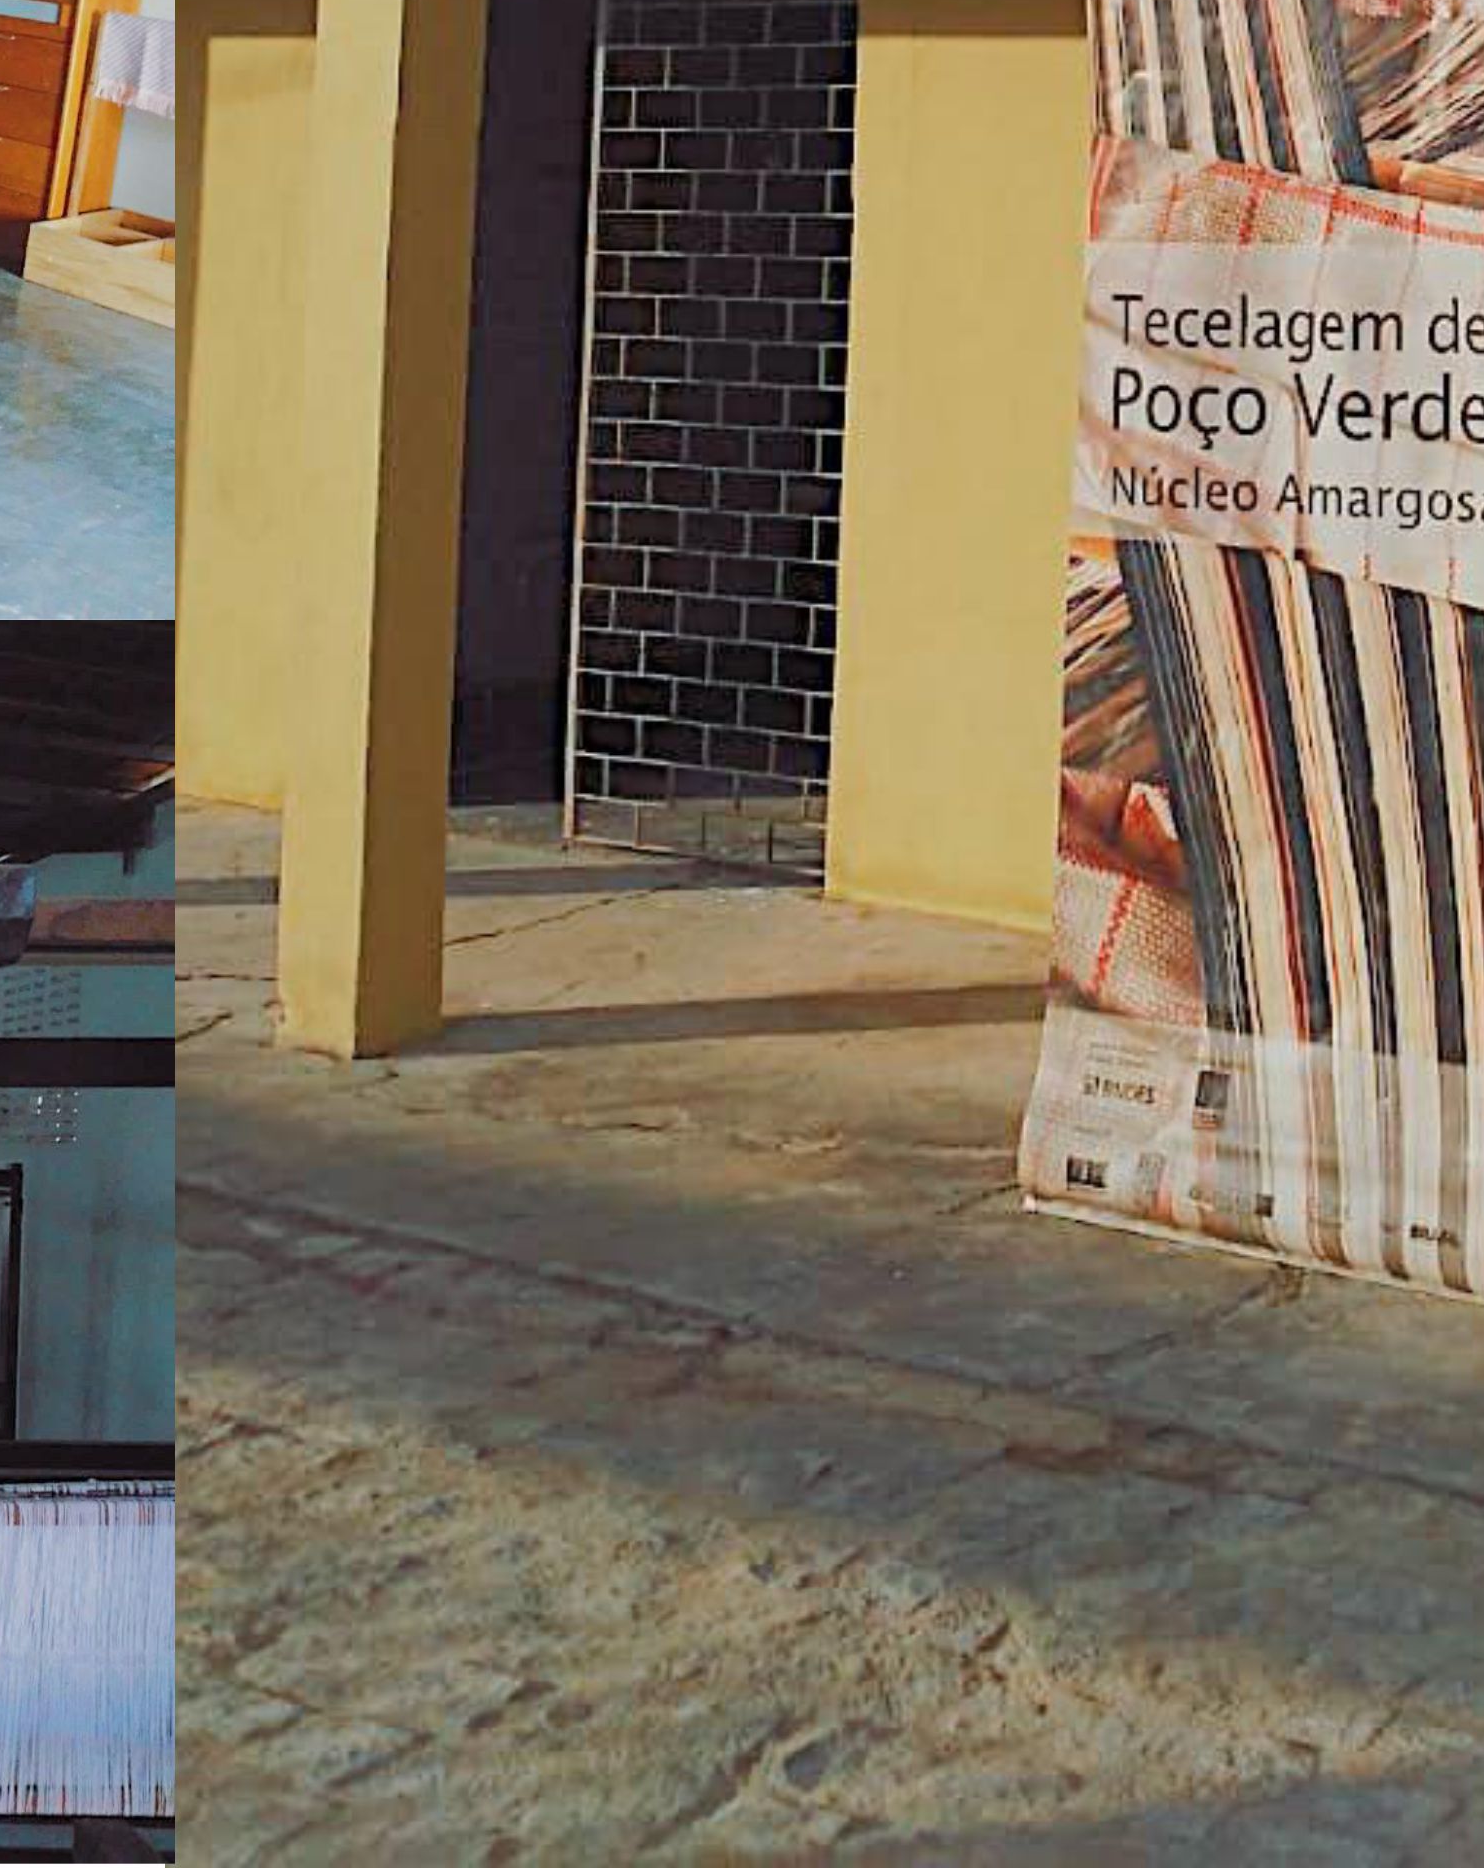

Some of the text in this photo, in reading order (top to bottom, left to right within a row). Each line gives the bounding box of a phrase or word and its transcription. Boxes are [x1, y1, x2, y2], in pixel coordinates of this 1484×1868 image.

[1113, 293, 1403, 363] Tecelagem
[1112, 366, 1267, 450] Poço
[1111, 465, 1258, 513] Núcleo
